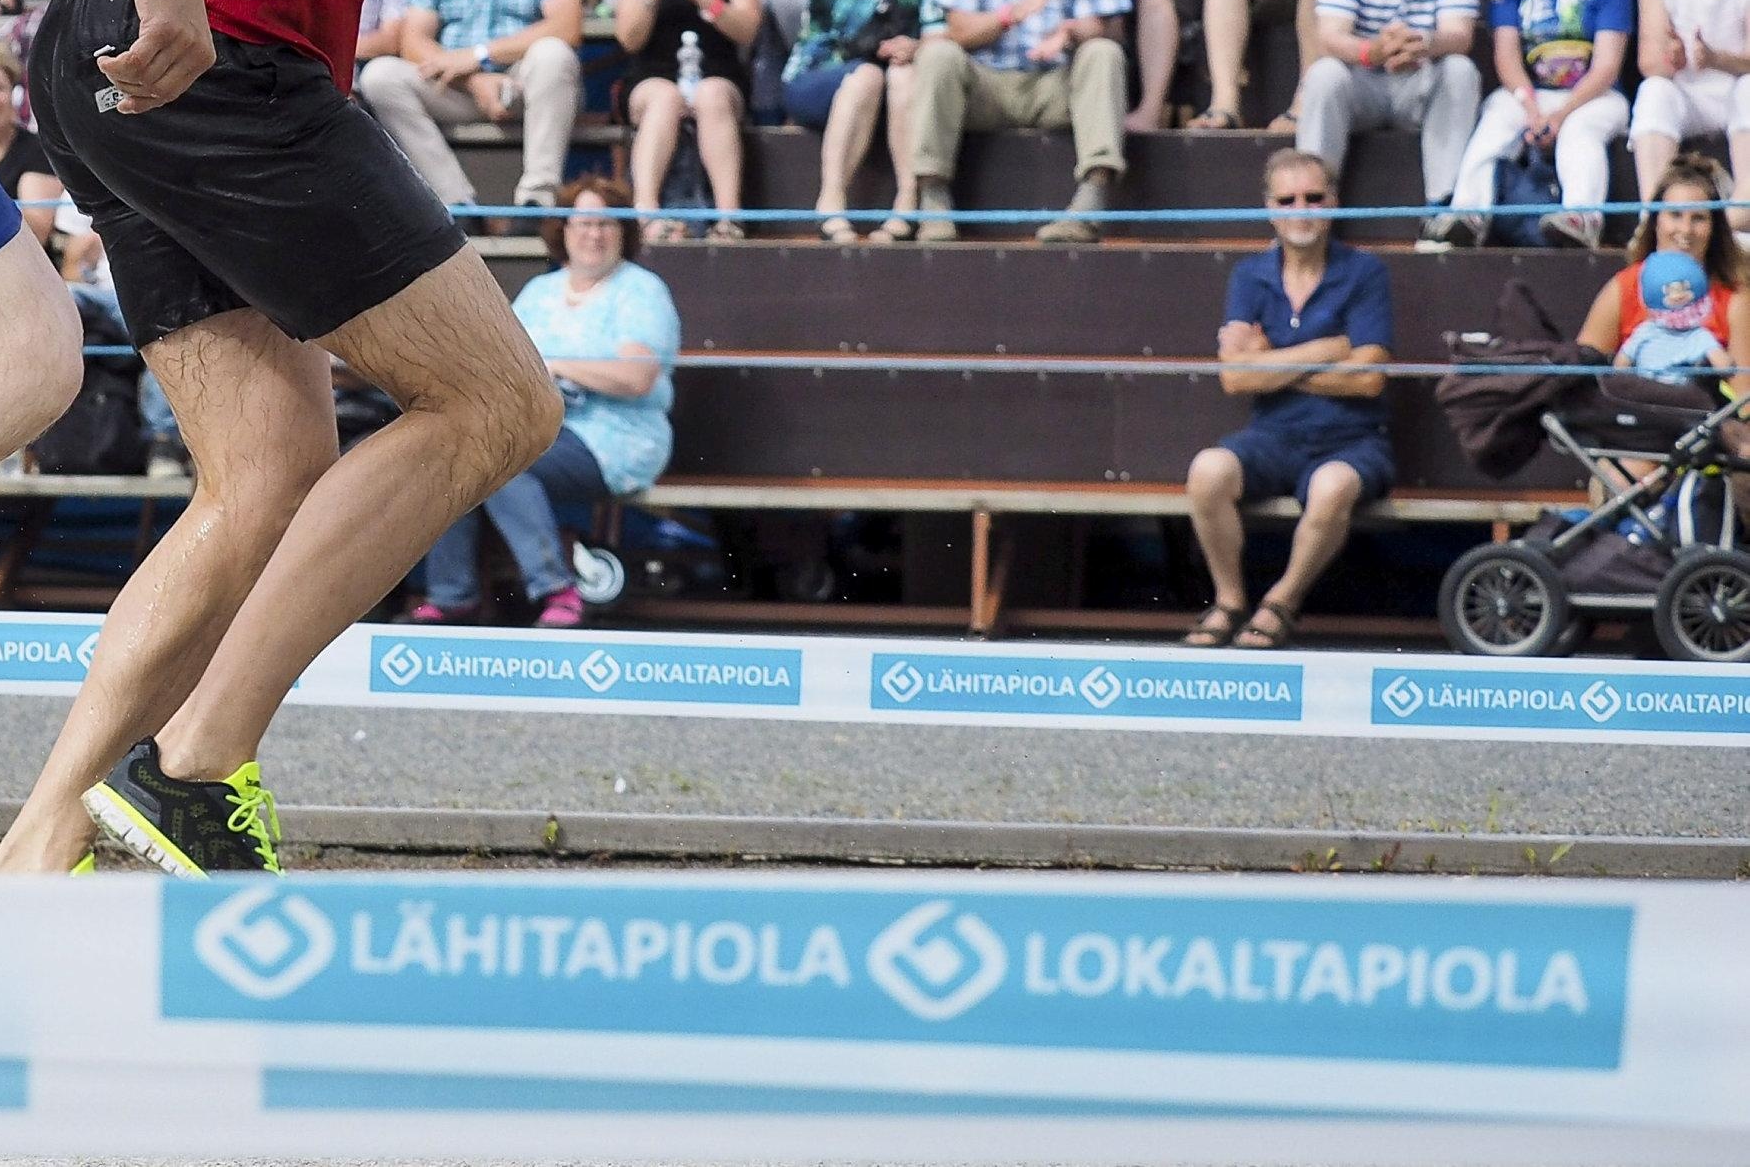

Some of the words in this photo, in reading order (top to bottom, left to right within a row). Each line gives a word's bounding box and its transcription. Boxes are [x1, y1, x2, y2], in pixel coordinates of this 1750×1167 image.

[426, 651, 575, 681] LÄHITAPIOLA
[624, 661, 792, 688] LOKALTAPIOLA
[927, 668, 1076, 697] LÄHITAPIOLA
[1125, 676, 1292, 703] LOKALTAPIOLA
[1428, 683, 1576, 711] LÄHITAPIOLA
[1625, 690, 1750, 715] LOKALTAPI
[351, 900, 851, 988] LÄHITAPIOLA
[1024, 930, 1589, 1014] LOKALTAPIOLA
